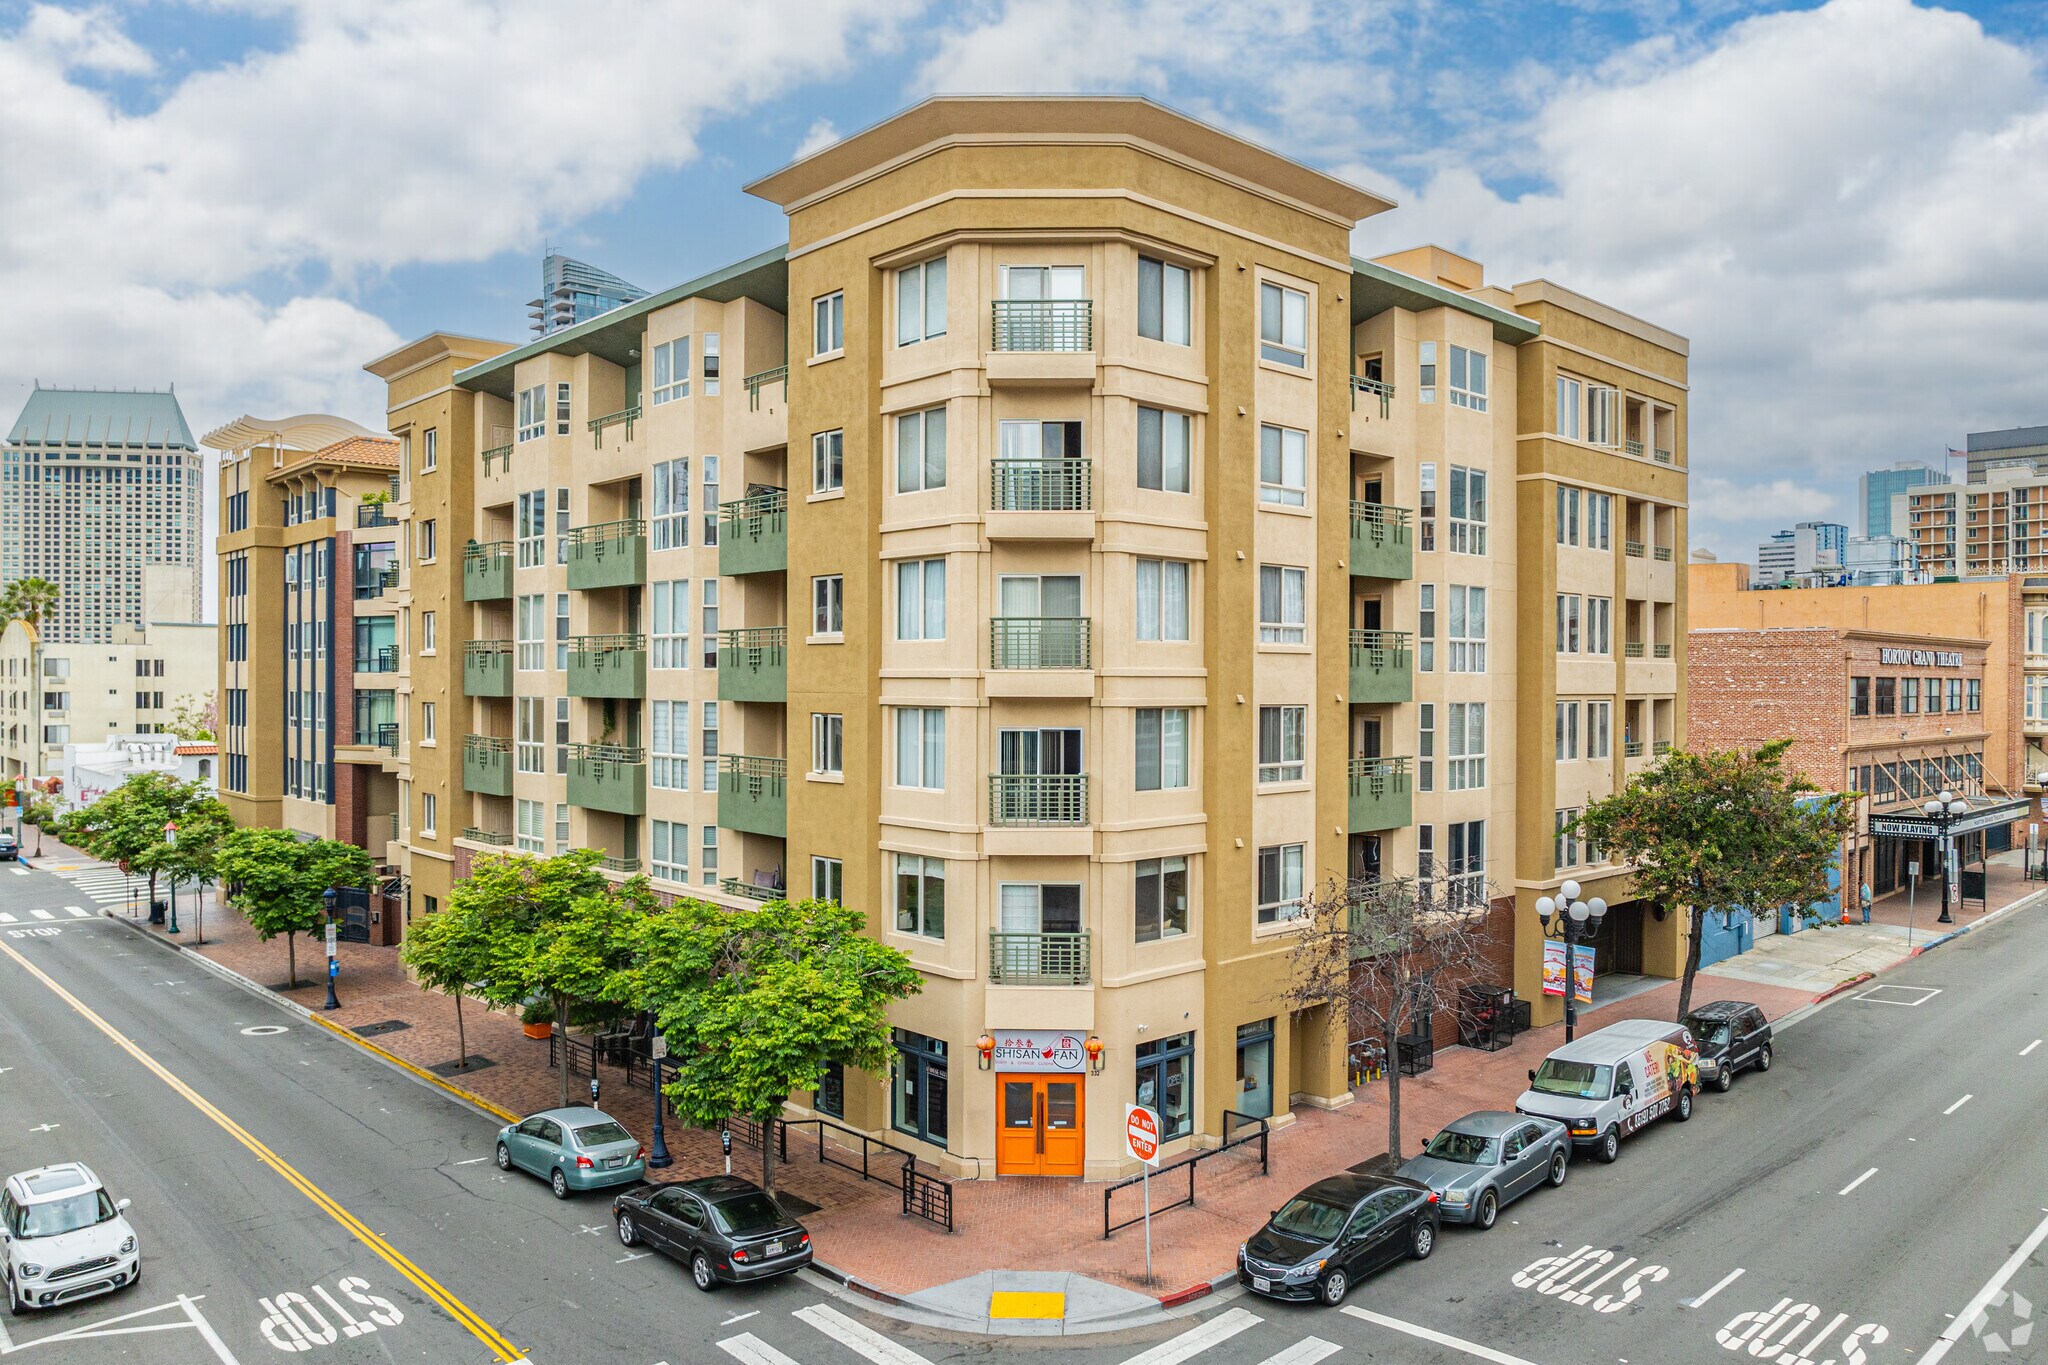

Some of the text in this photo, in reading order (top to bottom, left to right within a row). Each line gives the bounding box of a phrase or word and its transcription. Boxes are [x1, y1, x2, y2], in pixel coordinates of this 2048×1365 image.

[1882, 648, 1963, 667] HORTON GRAND THEATRE
[1881, 823, 1933, 834] NOW PLAYING
[7, 927, 62, 938] STOP
[996, 1048, 1078, 1060] SHISAN FAN
[1130, 1114, 1154, 1131] DO NOT
[1132, 1138, 1153, 1154] ENTER
[1512, 1245, 1669, 1313] STOP
[259, 1276, 404, 1352] STOP
[1715, 1297, 1889, 1365] STOP
